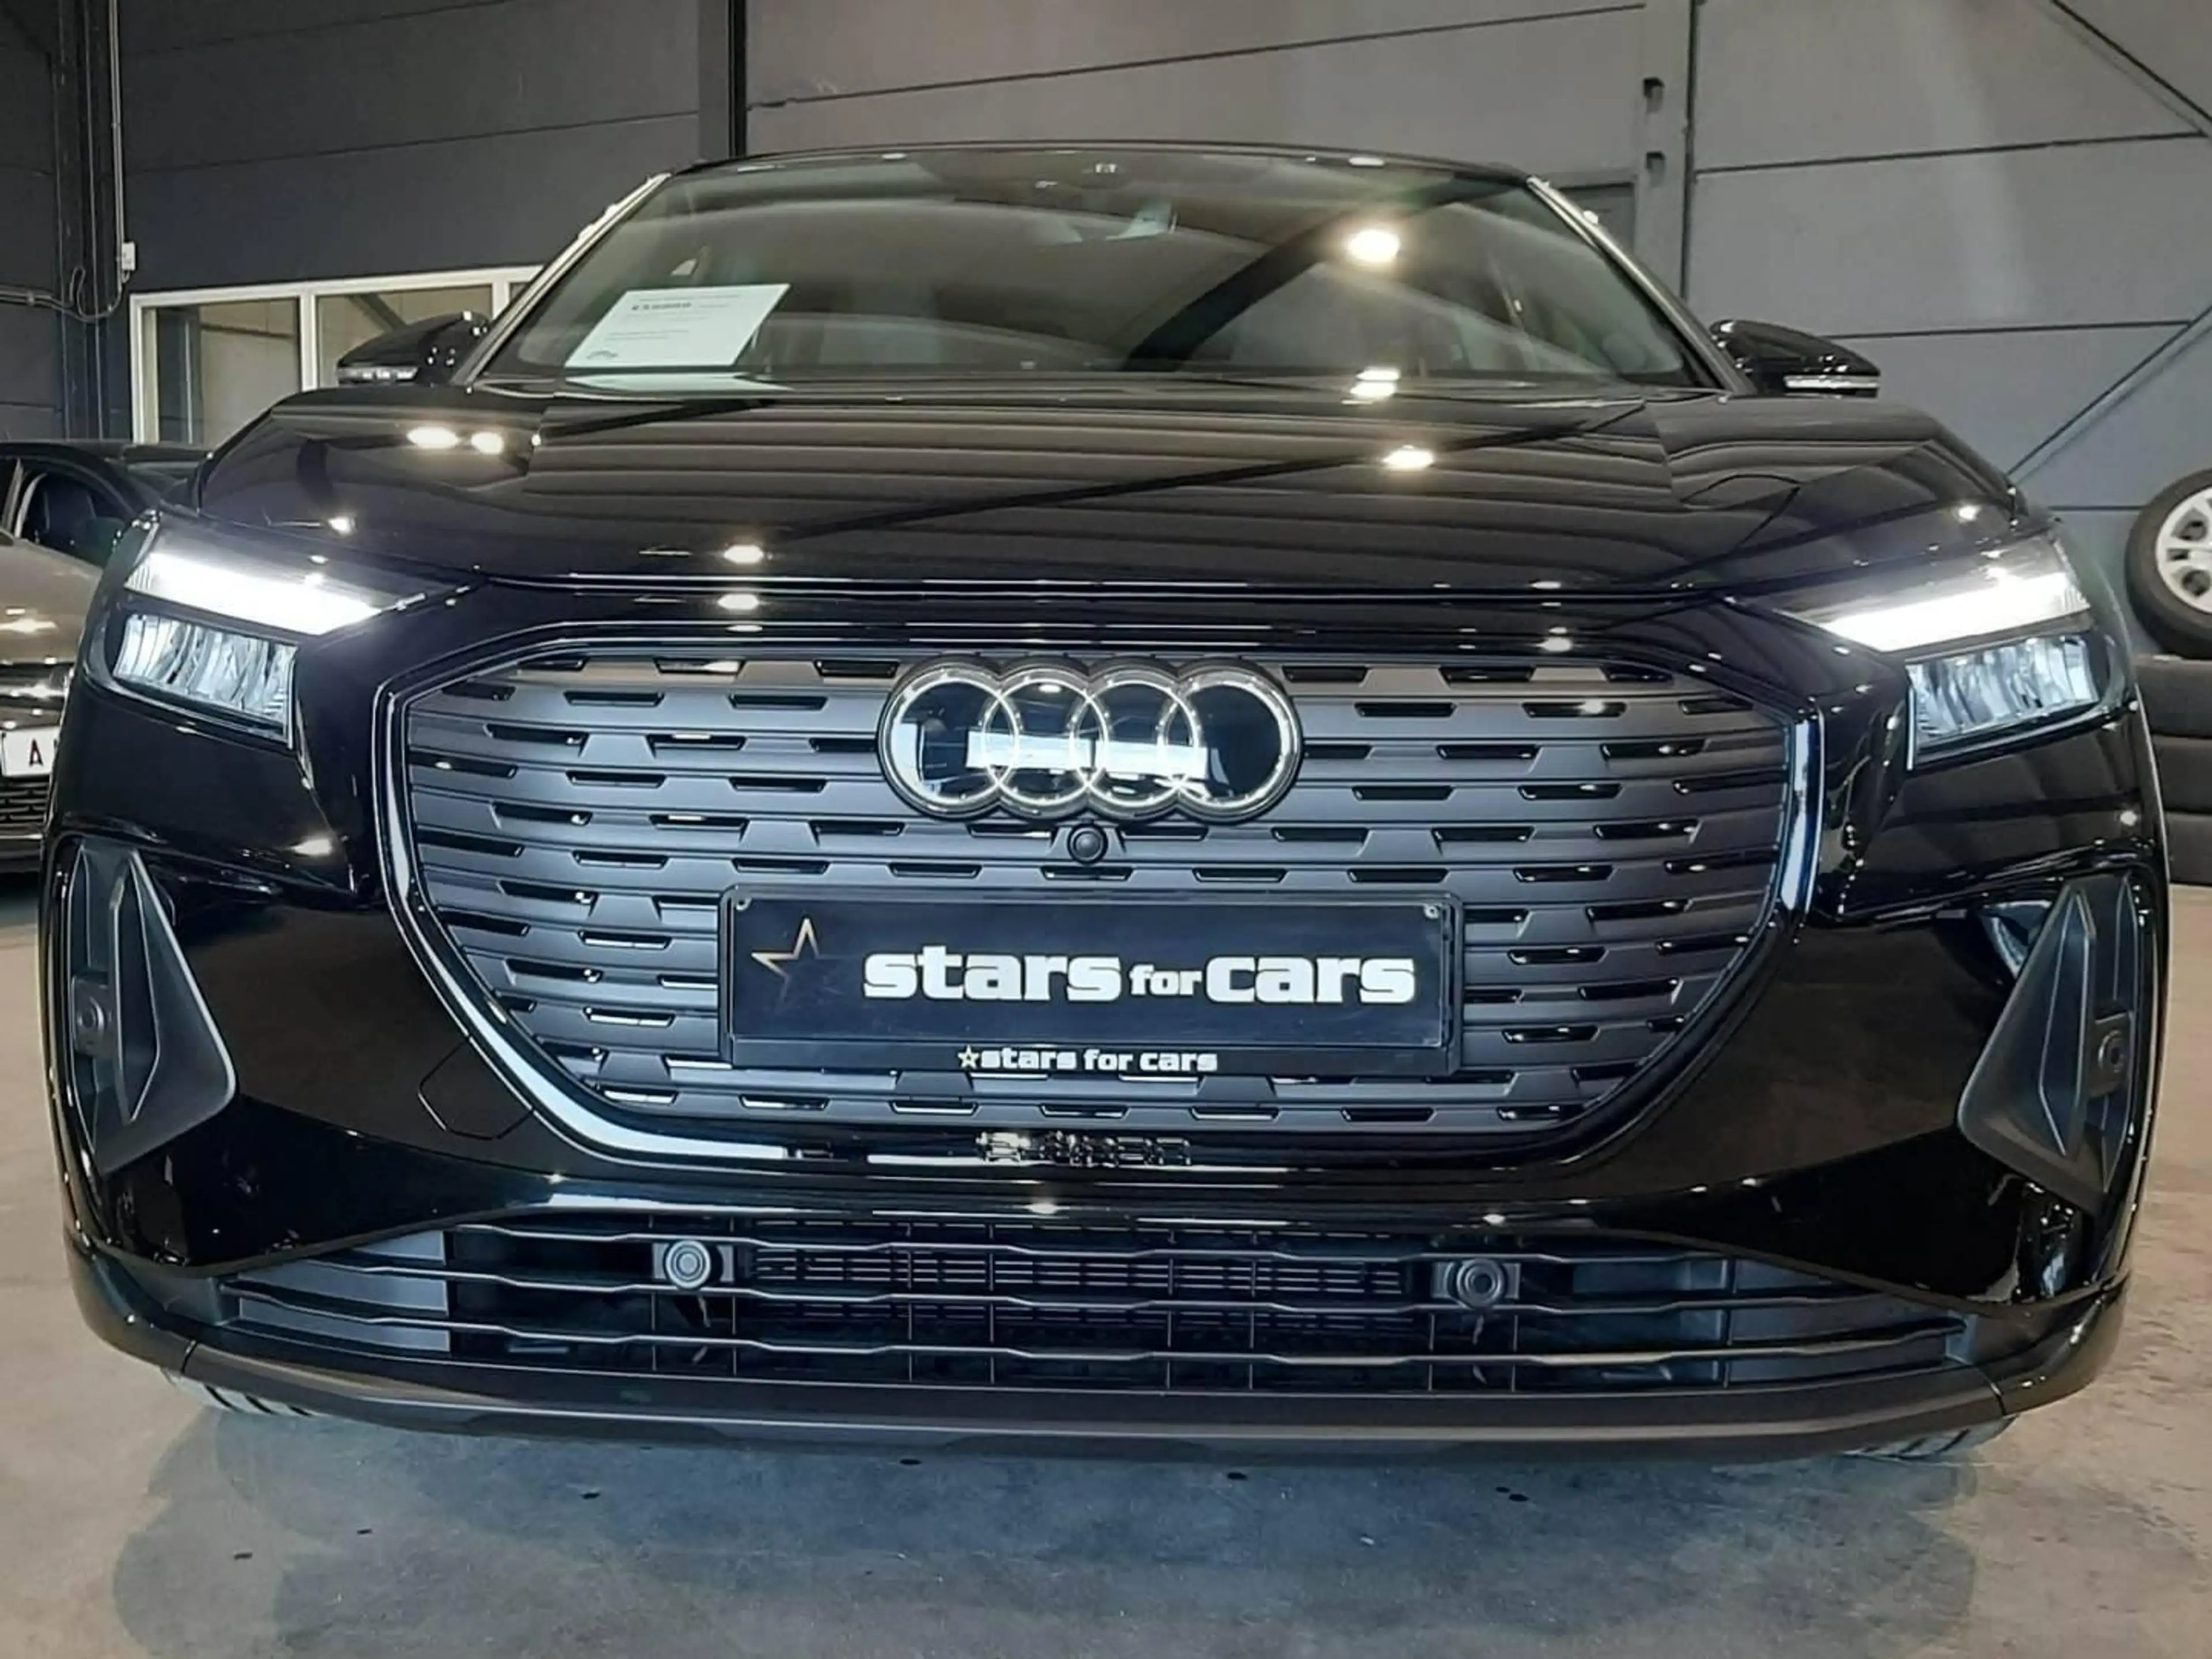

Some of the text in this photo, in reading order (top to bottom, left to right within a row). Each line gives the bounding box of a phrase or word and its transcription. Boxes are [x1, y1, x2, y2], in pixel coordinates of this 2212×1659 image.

[863, 945, 1416, 1003] stars for cars
[980, 1048, 1218, 1072] stars for cars
